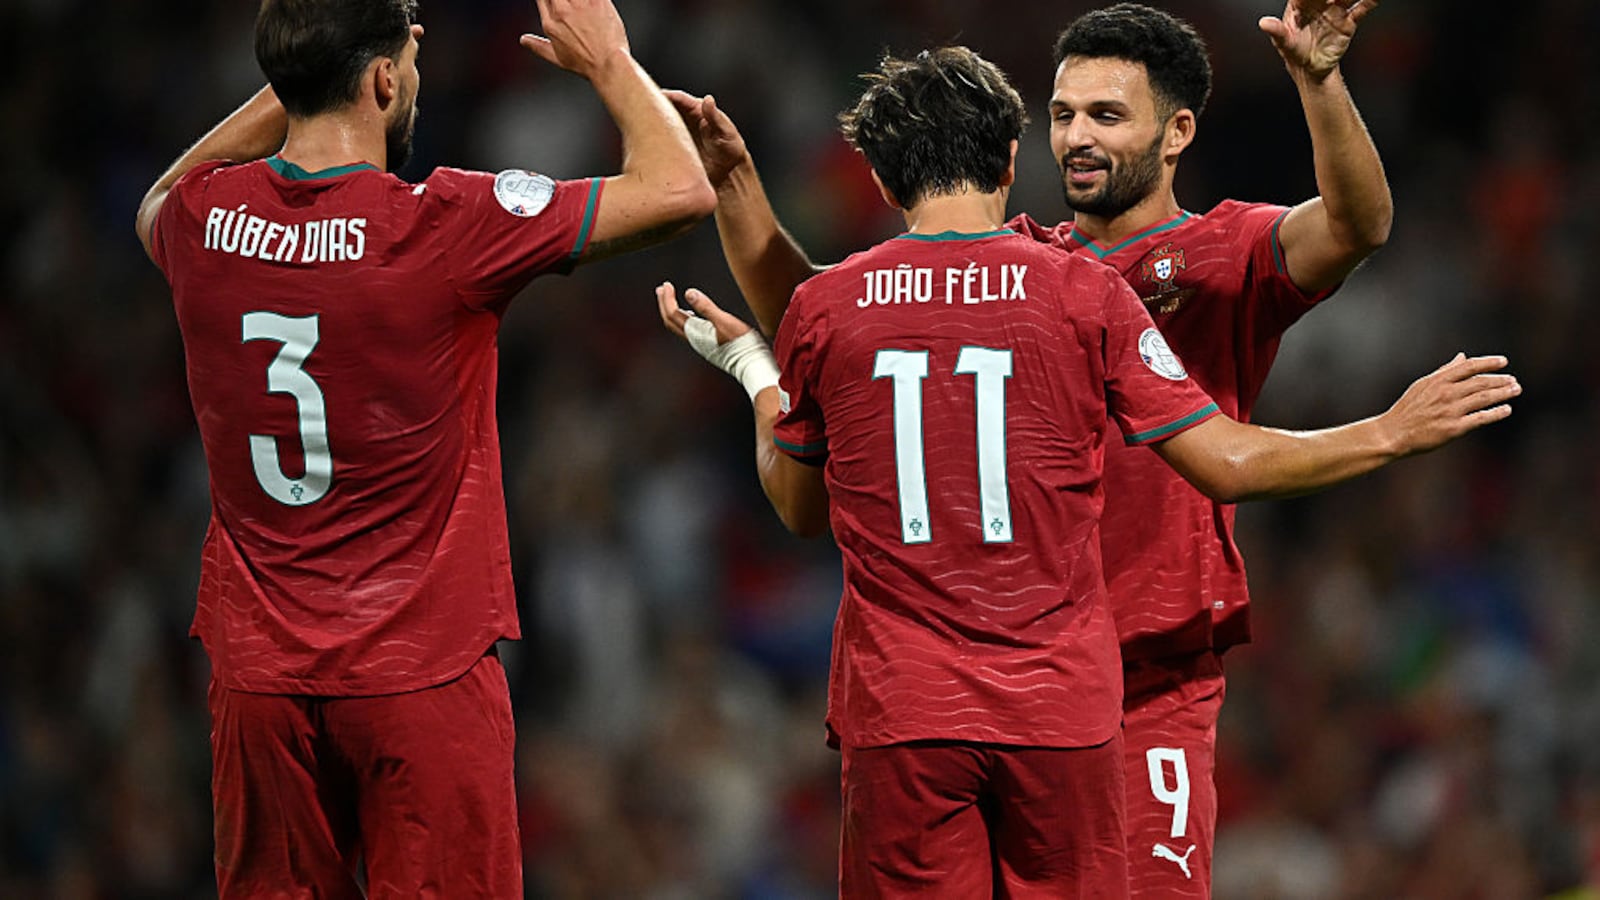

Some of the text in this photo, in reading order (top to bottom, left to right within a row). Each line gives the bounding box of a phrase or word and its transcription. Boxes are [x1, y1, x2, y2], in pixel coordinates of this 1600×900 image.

[204, 204, 367, 263] RÚBEN DIAS
[857, 262, 1028, 308] JOÃO FÉLIX
[241, 311, 333, 505] 3
[872, 345, 1013, 543] 11
[1146, 748, 1190, 837] 9
